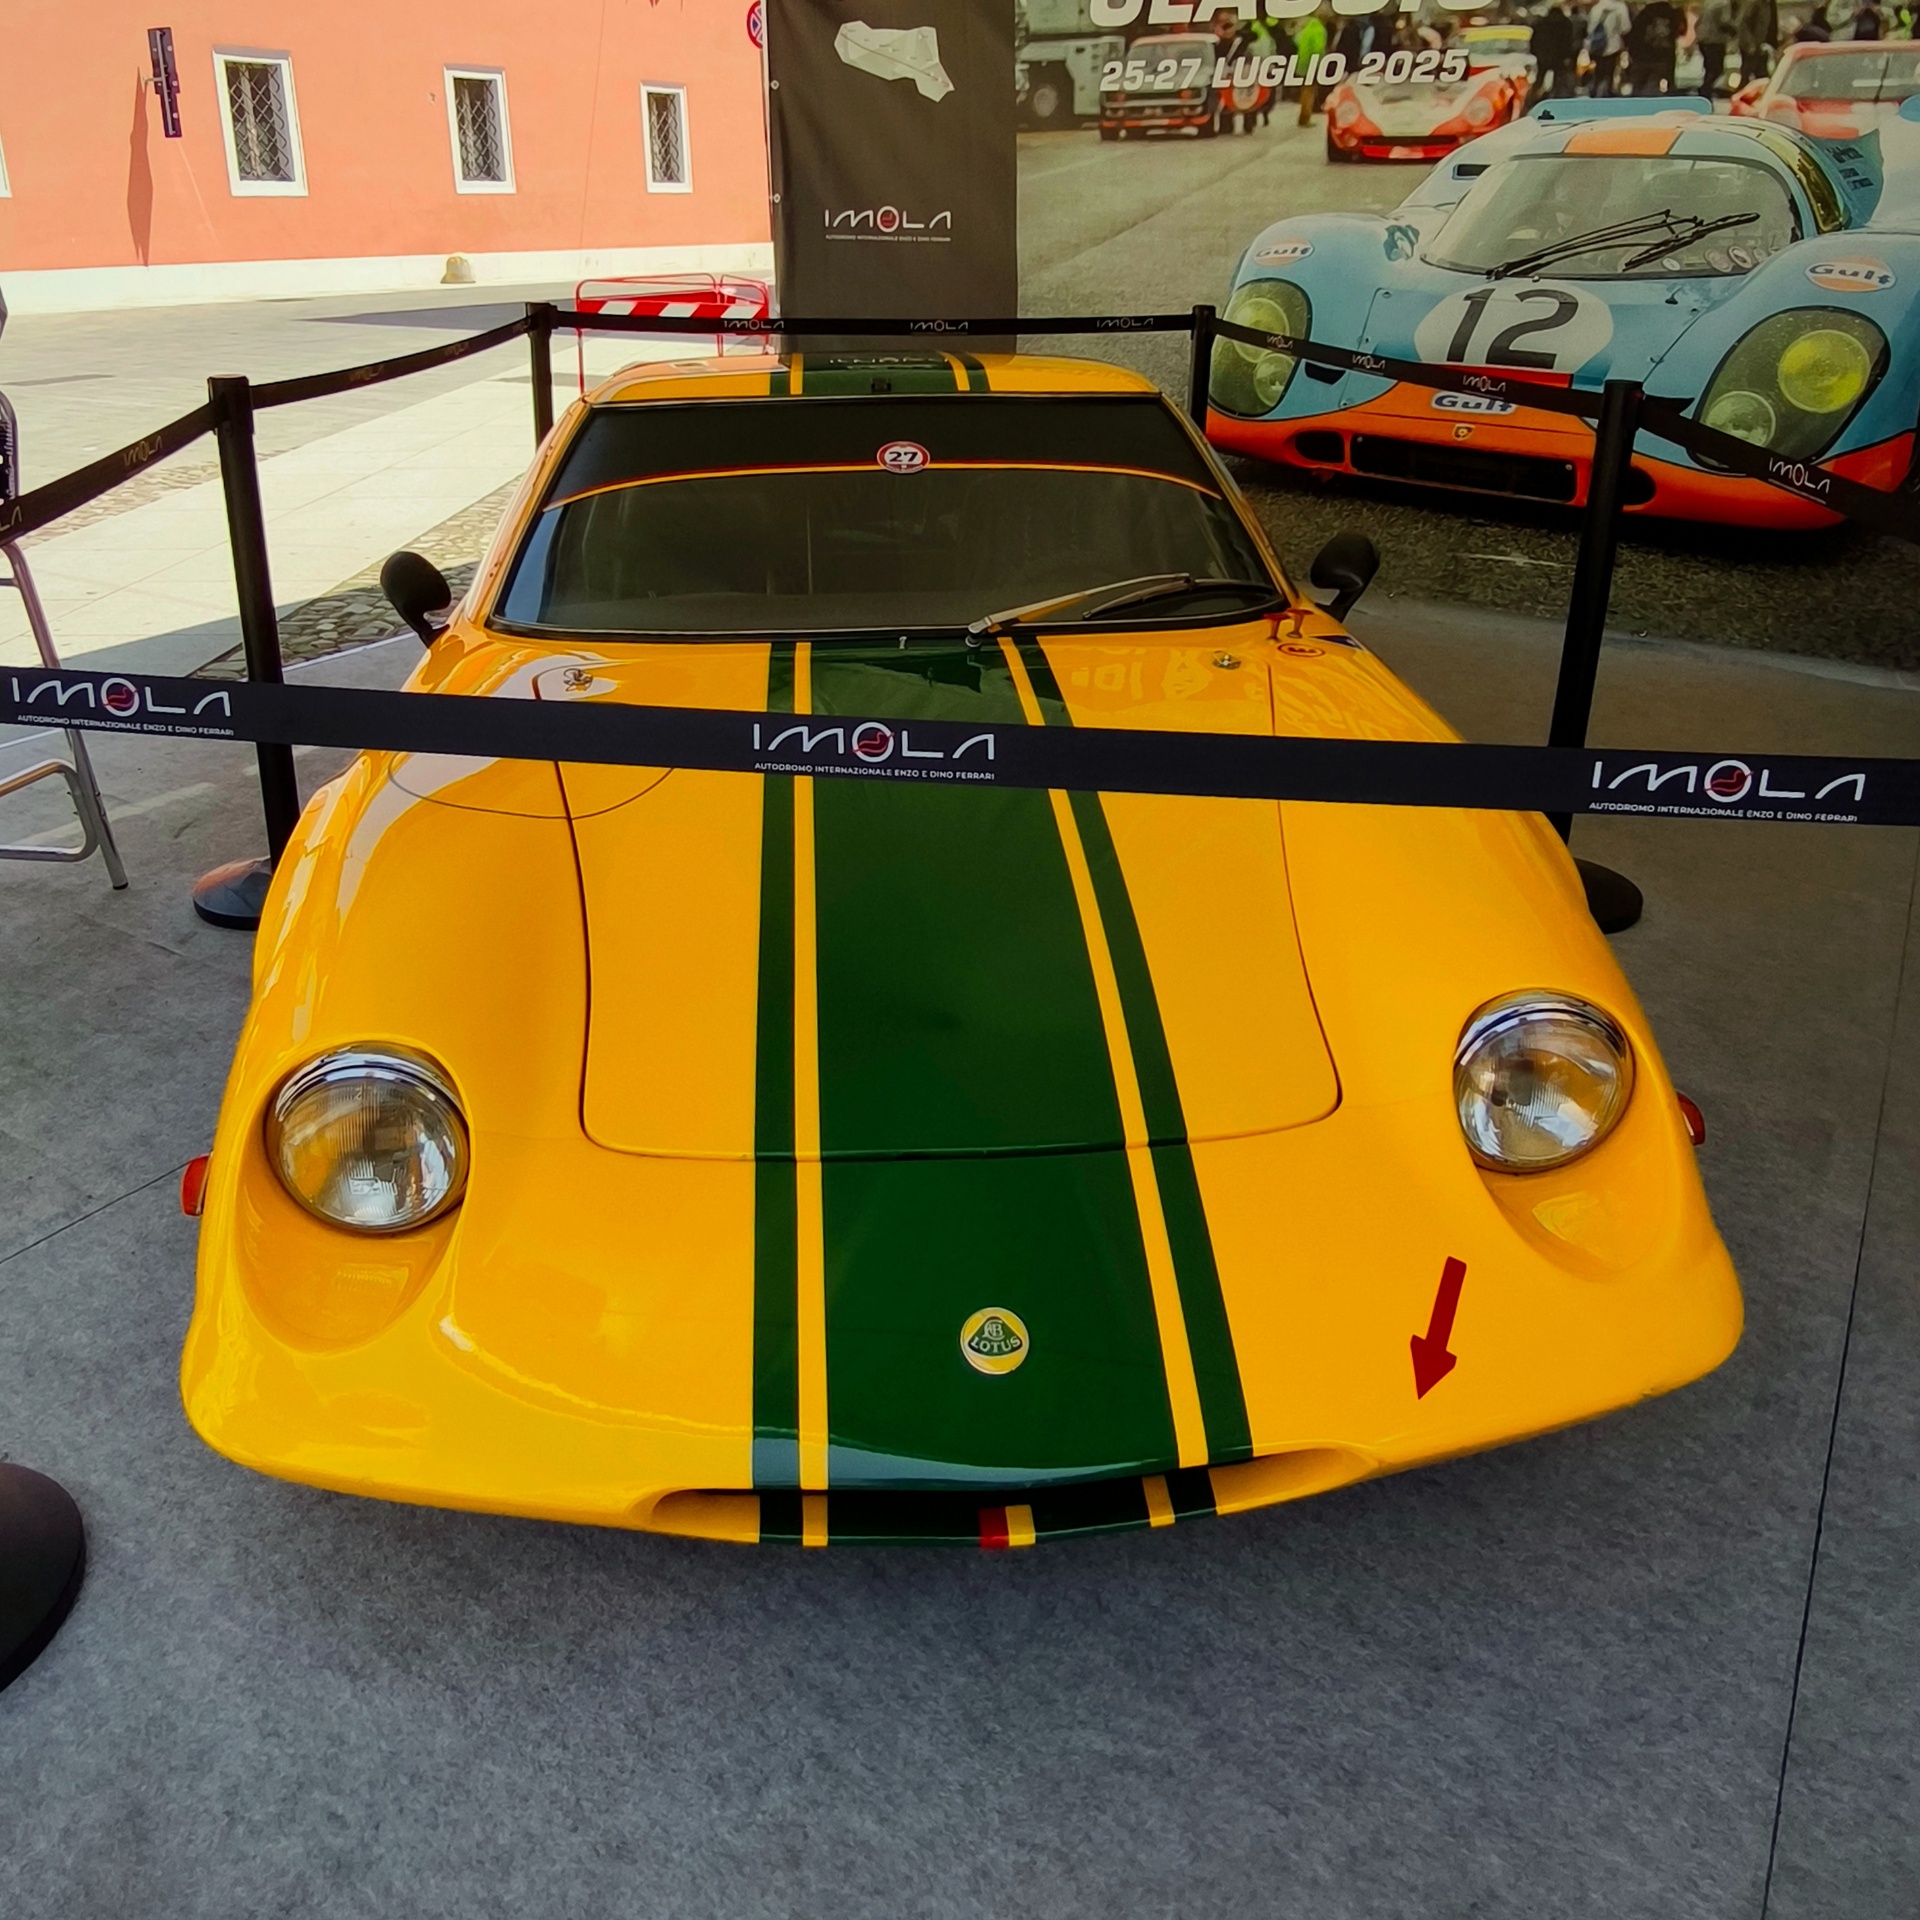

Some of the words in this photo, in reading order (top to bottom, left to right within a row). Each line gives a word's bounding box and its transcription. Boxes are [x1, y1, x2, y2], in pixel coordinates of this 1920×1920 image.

[1100, 58, 1201, 92] 25-27
[1211, 53, 1347, 88] LUGLIO
[1355, 48, 1470, 85] 2025
[824, 205, 952, 233] IMOLA
[1808, 263, 1892, 285] Gulf
[724, 319, 785, 331] IMOLA
[910, 319, 969, 332] IMOLA
[1096, 317, 1154, 329] IMOLA
[1447, 287, 1579, 370] 12
[888, 451, 919, 463] 27
[1768, 456, 1831, 494] IMOLA
[11, 677, 232, 717] IMOLA
[752, 721, 995, 763] IMOLA
[754, 762, 813, 773] AUTODROMO
[815, 765, 893, 776] INTERNAZIONALE
[894, 768, 920, 778] ENZO
[929, 770, 954, 779] DINO
[955, 771, 995, 781] FERRARI
[1591, 759, 1867, 804] IMOLA
[1588, 802, 1655, 813] AUTODROMO
[1657, 805, 1745, 818] INTERNAZIONALE
[1746, 809, 1775, 819] ENZO
[1785, 811, 1813, 821] DINO
[970, 1335, 1021, 1353] LOTUS
